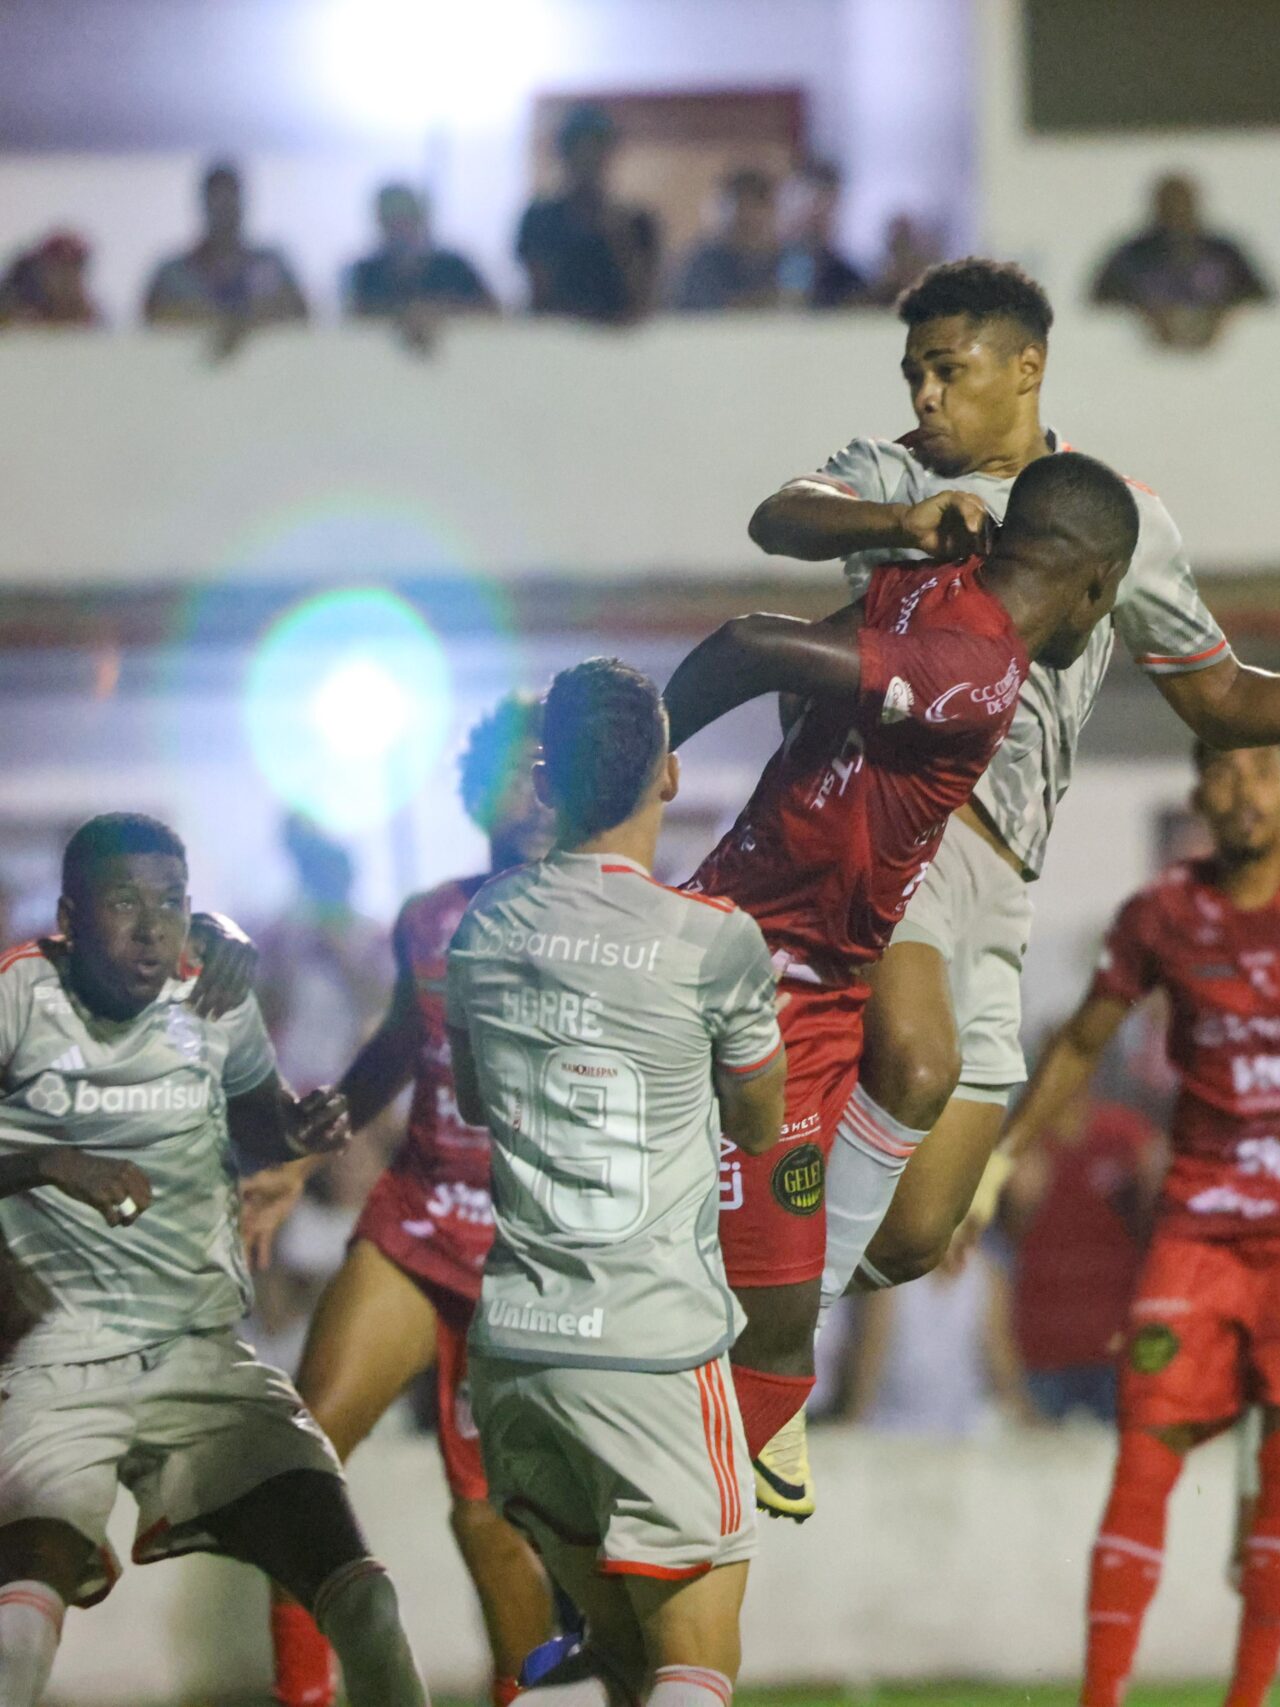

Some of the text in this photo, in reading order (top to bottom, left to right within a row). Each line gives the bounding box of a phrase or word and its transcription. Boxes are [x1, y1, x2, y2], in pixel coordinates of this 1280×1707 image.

[507, 927, 661, 972] banrisul
[74, 1078, 212, 1114] banrisul
[487, 1302, 604, 1338] Unimed
